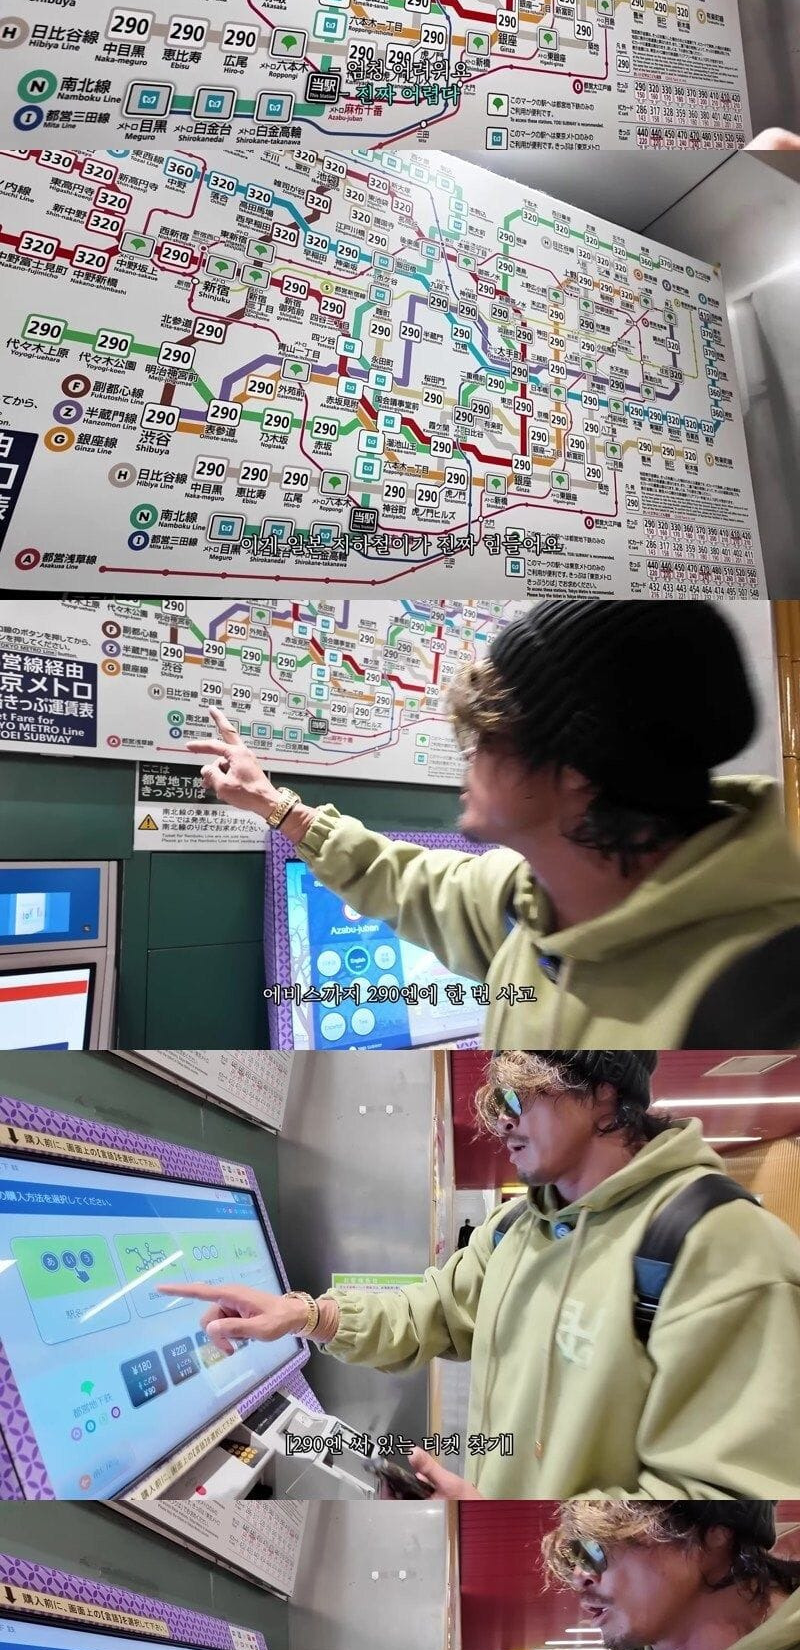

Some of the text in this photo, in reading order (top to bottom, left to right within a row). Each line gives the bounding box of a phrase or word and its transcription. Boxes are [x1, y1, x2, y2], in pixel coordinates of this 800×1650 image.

[110, 15, 149, 36] 290
[31, 24, 100, 45] 日比谷線
[103, 42, 145, 58] 中目黒
[161, 49, 201, 64] 恵比寿
[95, 55, 148, 66] Naka-meguro
[223, 55, 248, 69] 広尾
[60, 77, 112, 94] 南北線
[57, 92, 101, 103] Namboku
[46, 110, 110, 124] 都営三田線
[78, 352, 137, 371] 代々木公園
[92, 380, 145, 399] 副都心線
[85, 406, 138, 424] 半蔵門線
[77, 433, 118, 448] 銀座線
[18, 714, 42, 726] Fare
[19, 723, 85, 737] METRO Line
[20, 732, 72, 745] SUBWAY
